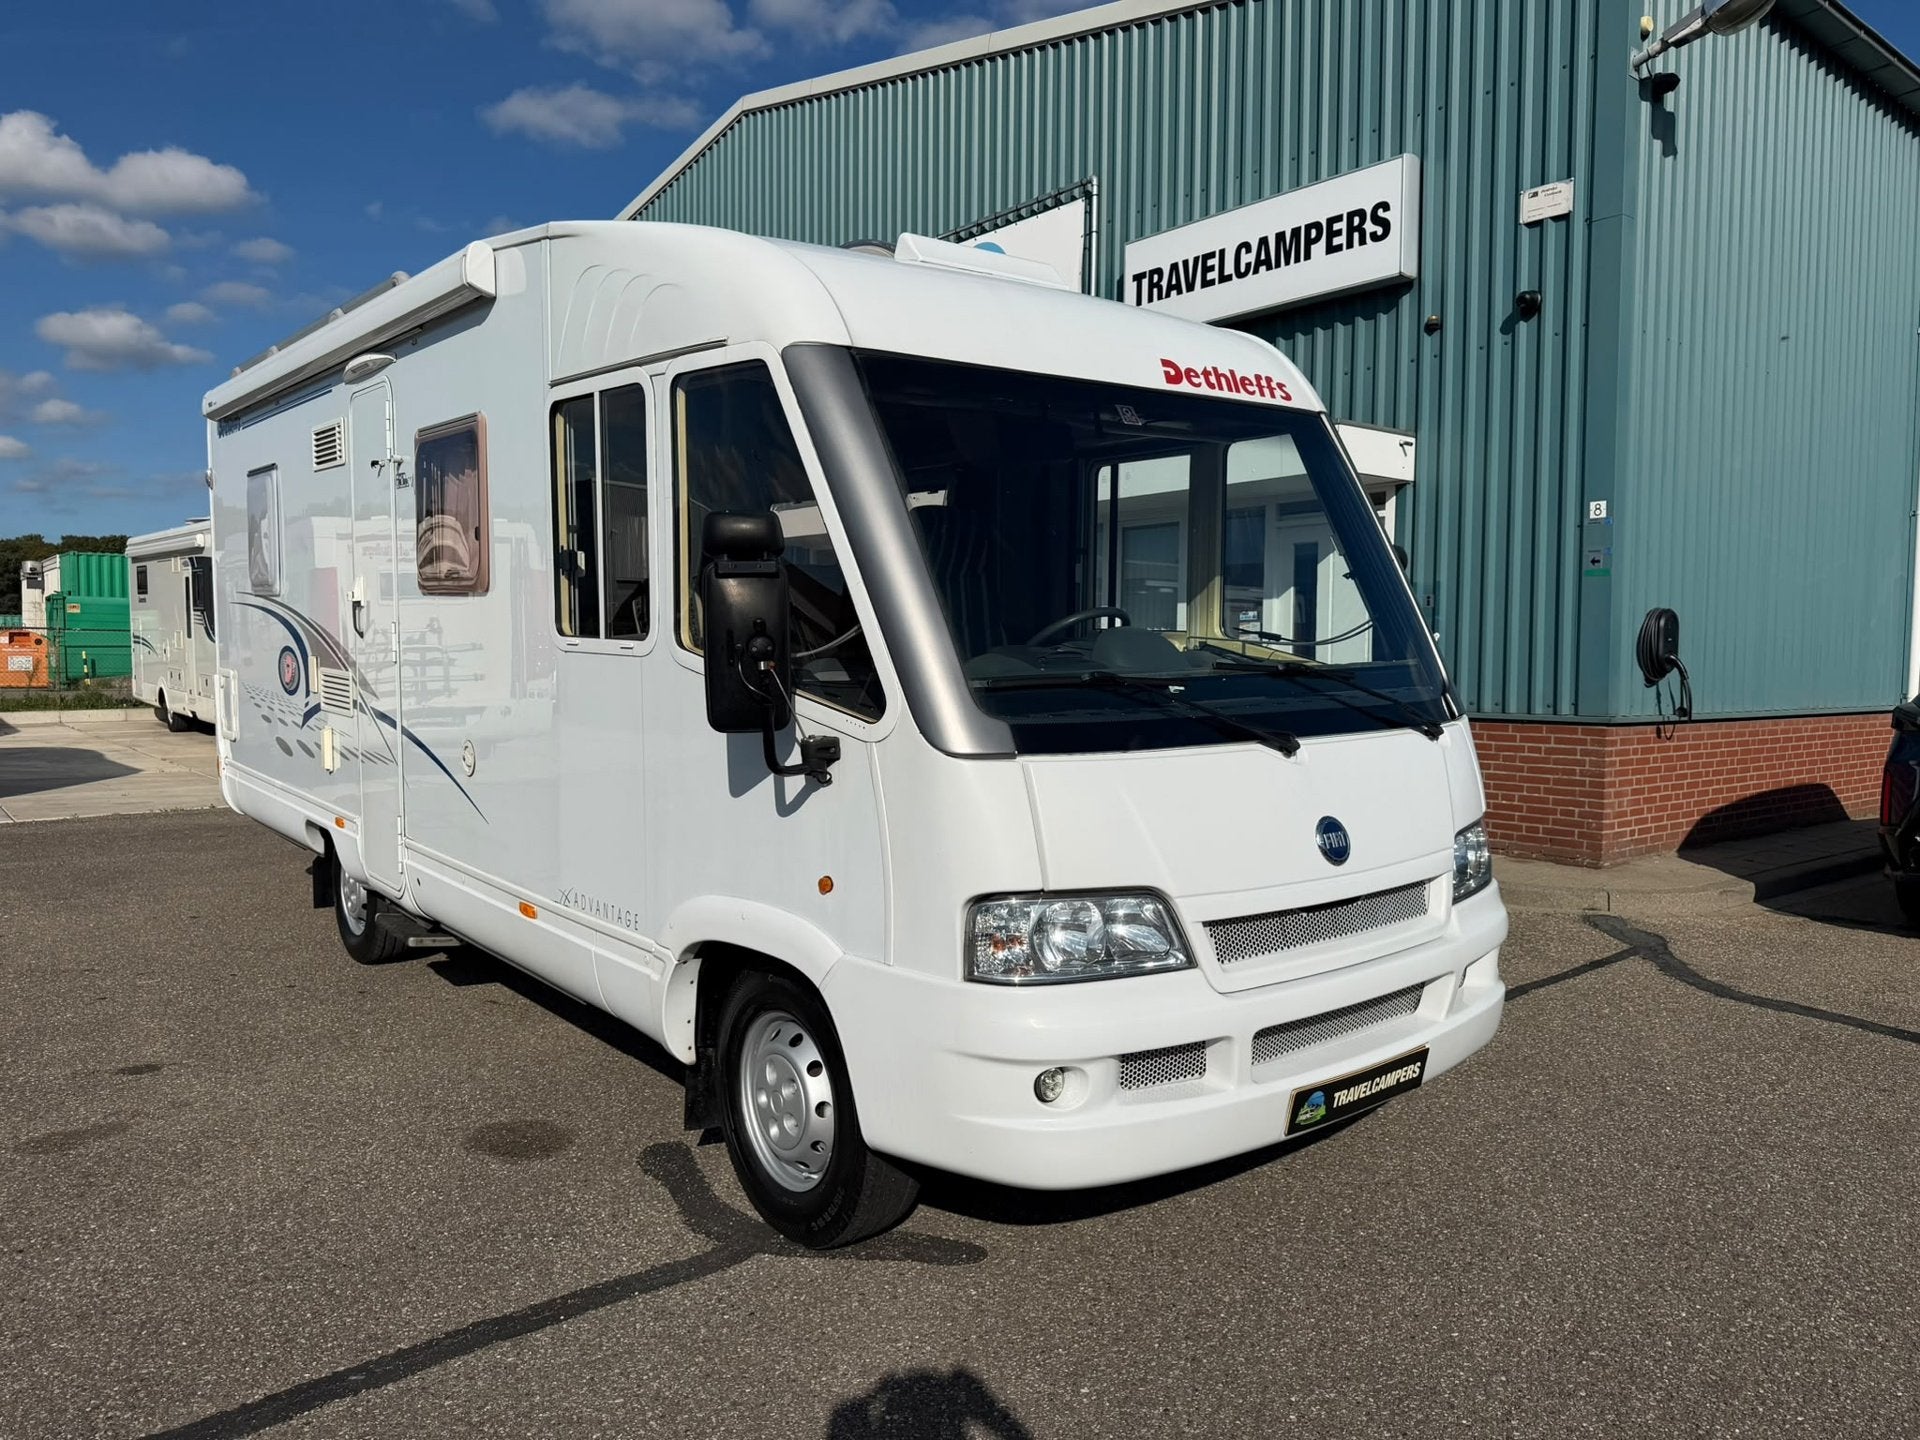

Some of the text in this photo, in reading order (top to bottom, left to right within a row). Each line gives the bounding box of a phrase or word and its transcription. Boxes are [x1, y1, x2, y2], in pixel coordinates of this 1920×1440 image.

[1132, 200, 1392, 307] TRAVELCAMPERS
[1160, 358, 1292, 402] Dethleffs
[1593, 502, 1603, 517] 8
[1323, 831, 1346, 850] FIAT
[1332, 1061, 1422, 1109] TRAVELCAMPERS
